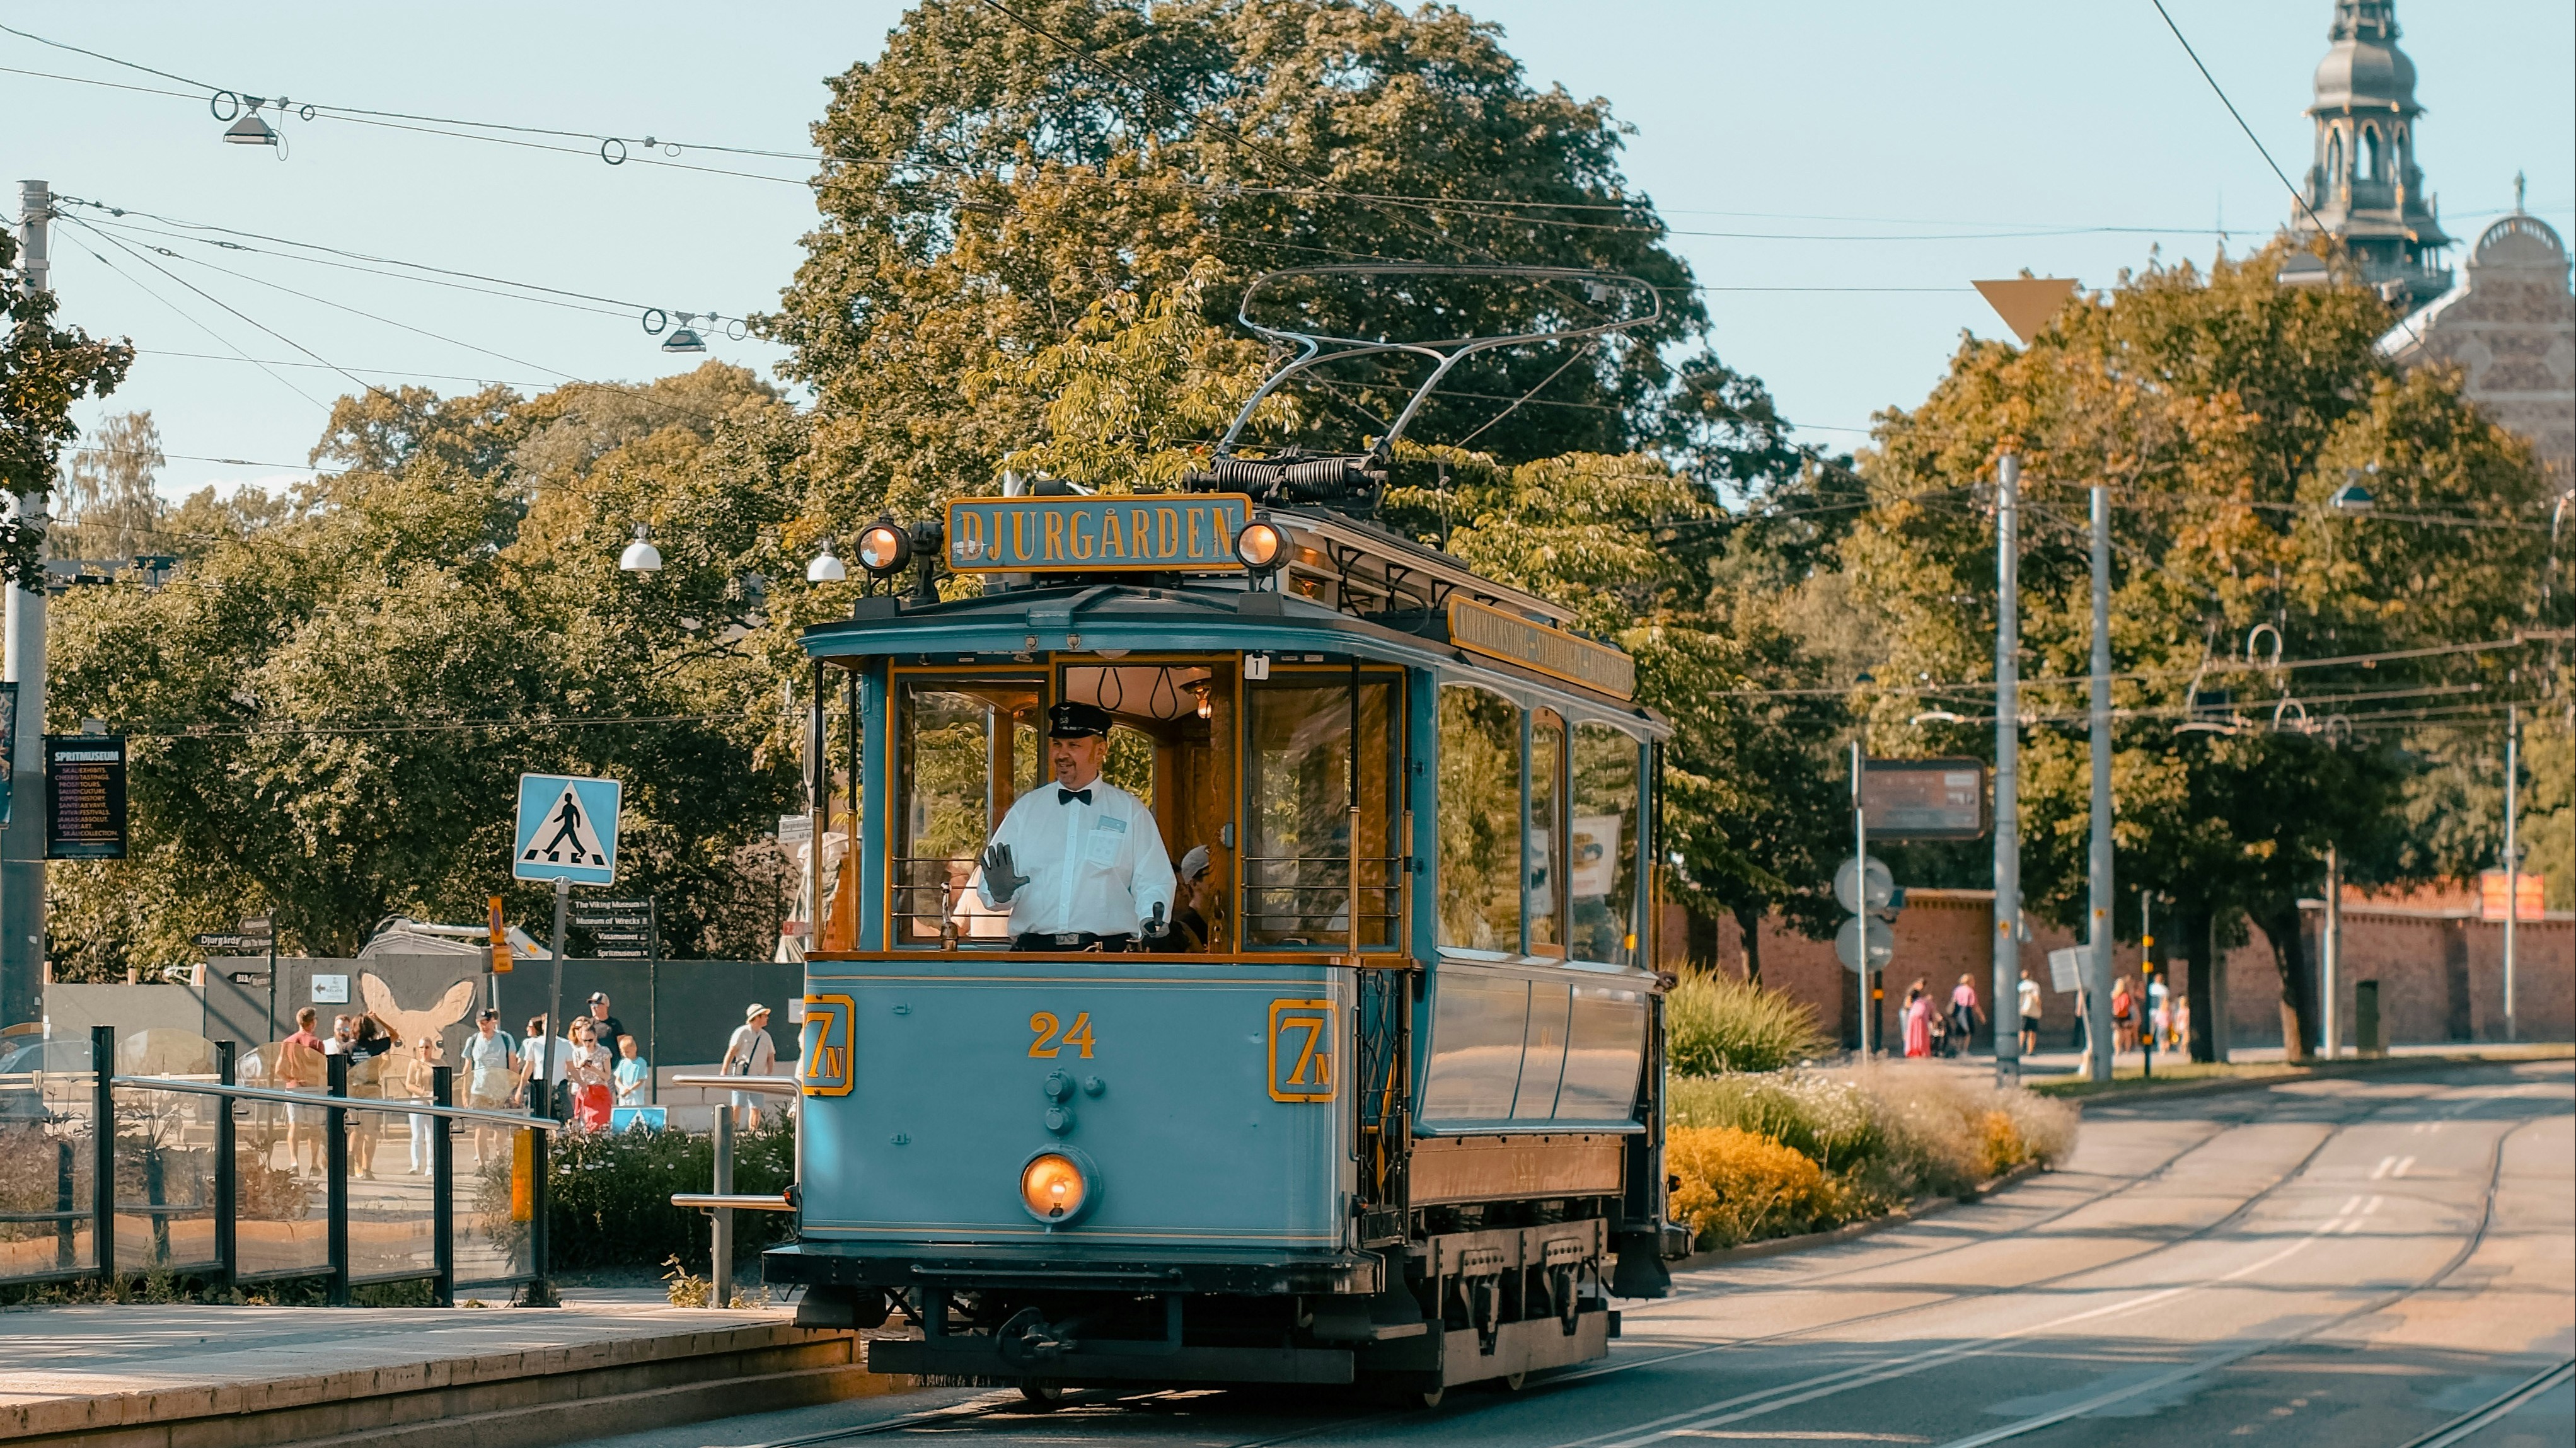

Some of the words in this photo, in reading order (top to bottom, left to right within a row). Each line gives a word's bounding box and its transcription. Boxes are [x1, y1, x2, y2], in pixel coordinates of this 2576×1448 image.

[960, 506, 1235, 562] DJURGÅRDEN
[1254, 660, 1259, 676] 1
[55, 751, 118, 761] SPRITMUSEUM
[589, 901, 611, 909] Viking
[598, 932, 638, 940] Vasamuseet
[597, 949, 642, 958] Spritmuseum
[1027, 1011, 1097, 1059] 24
